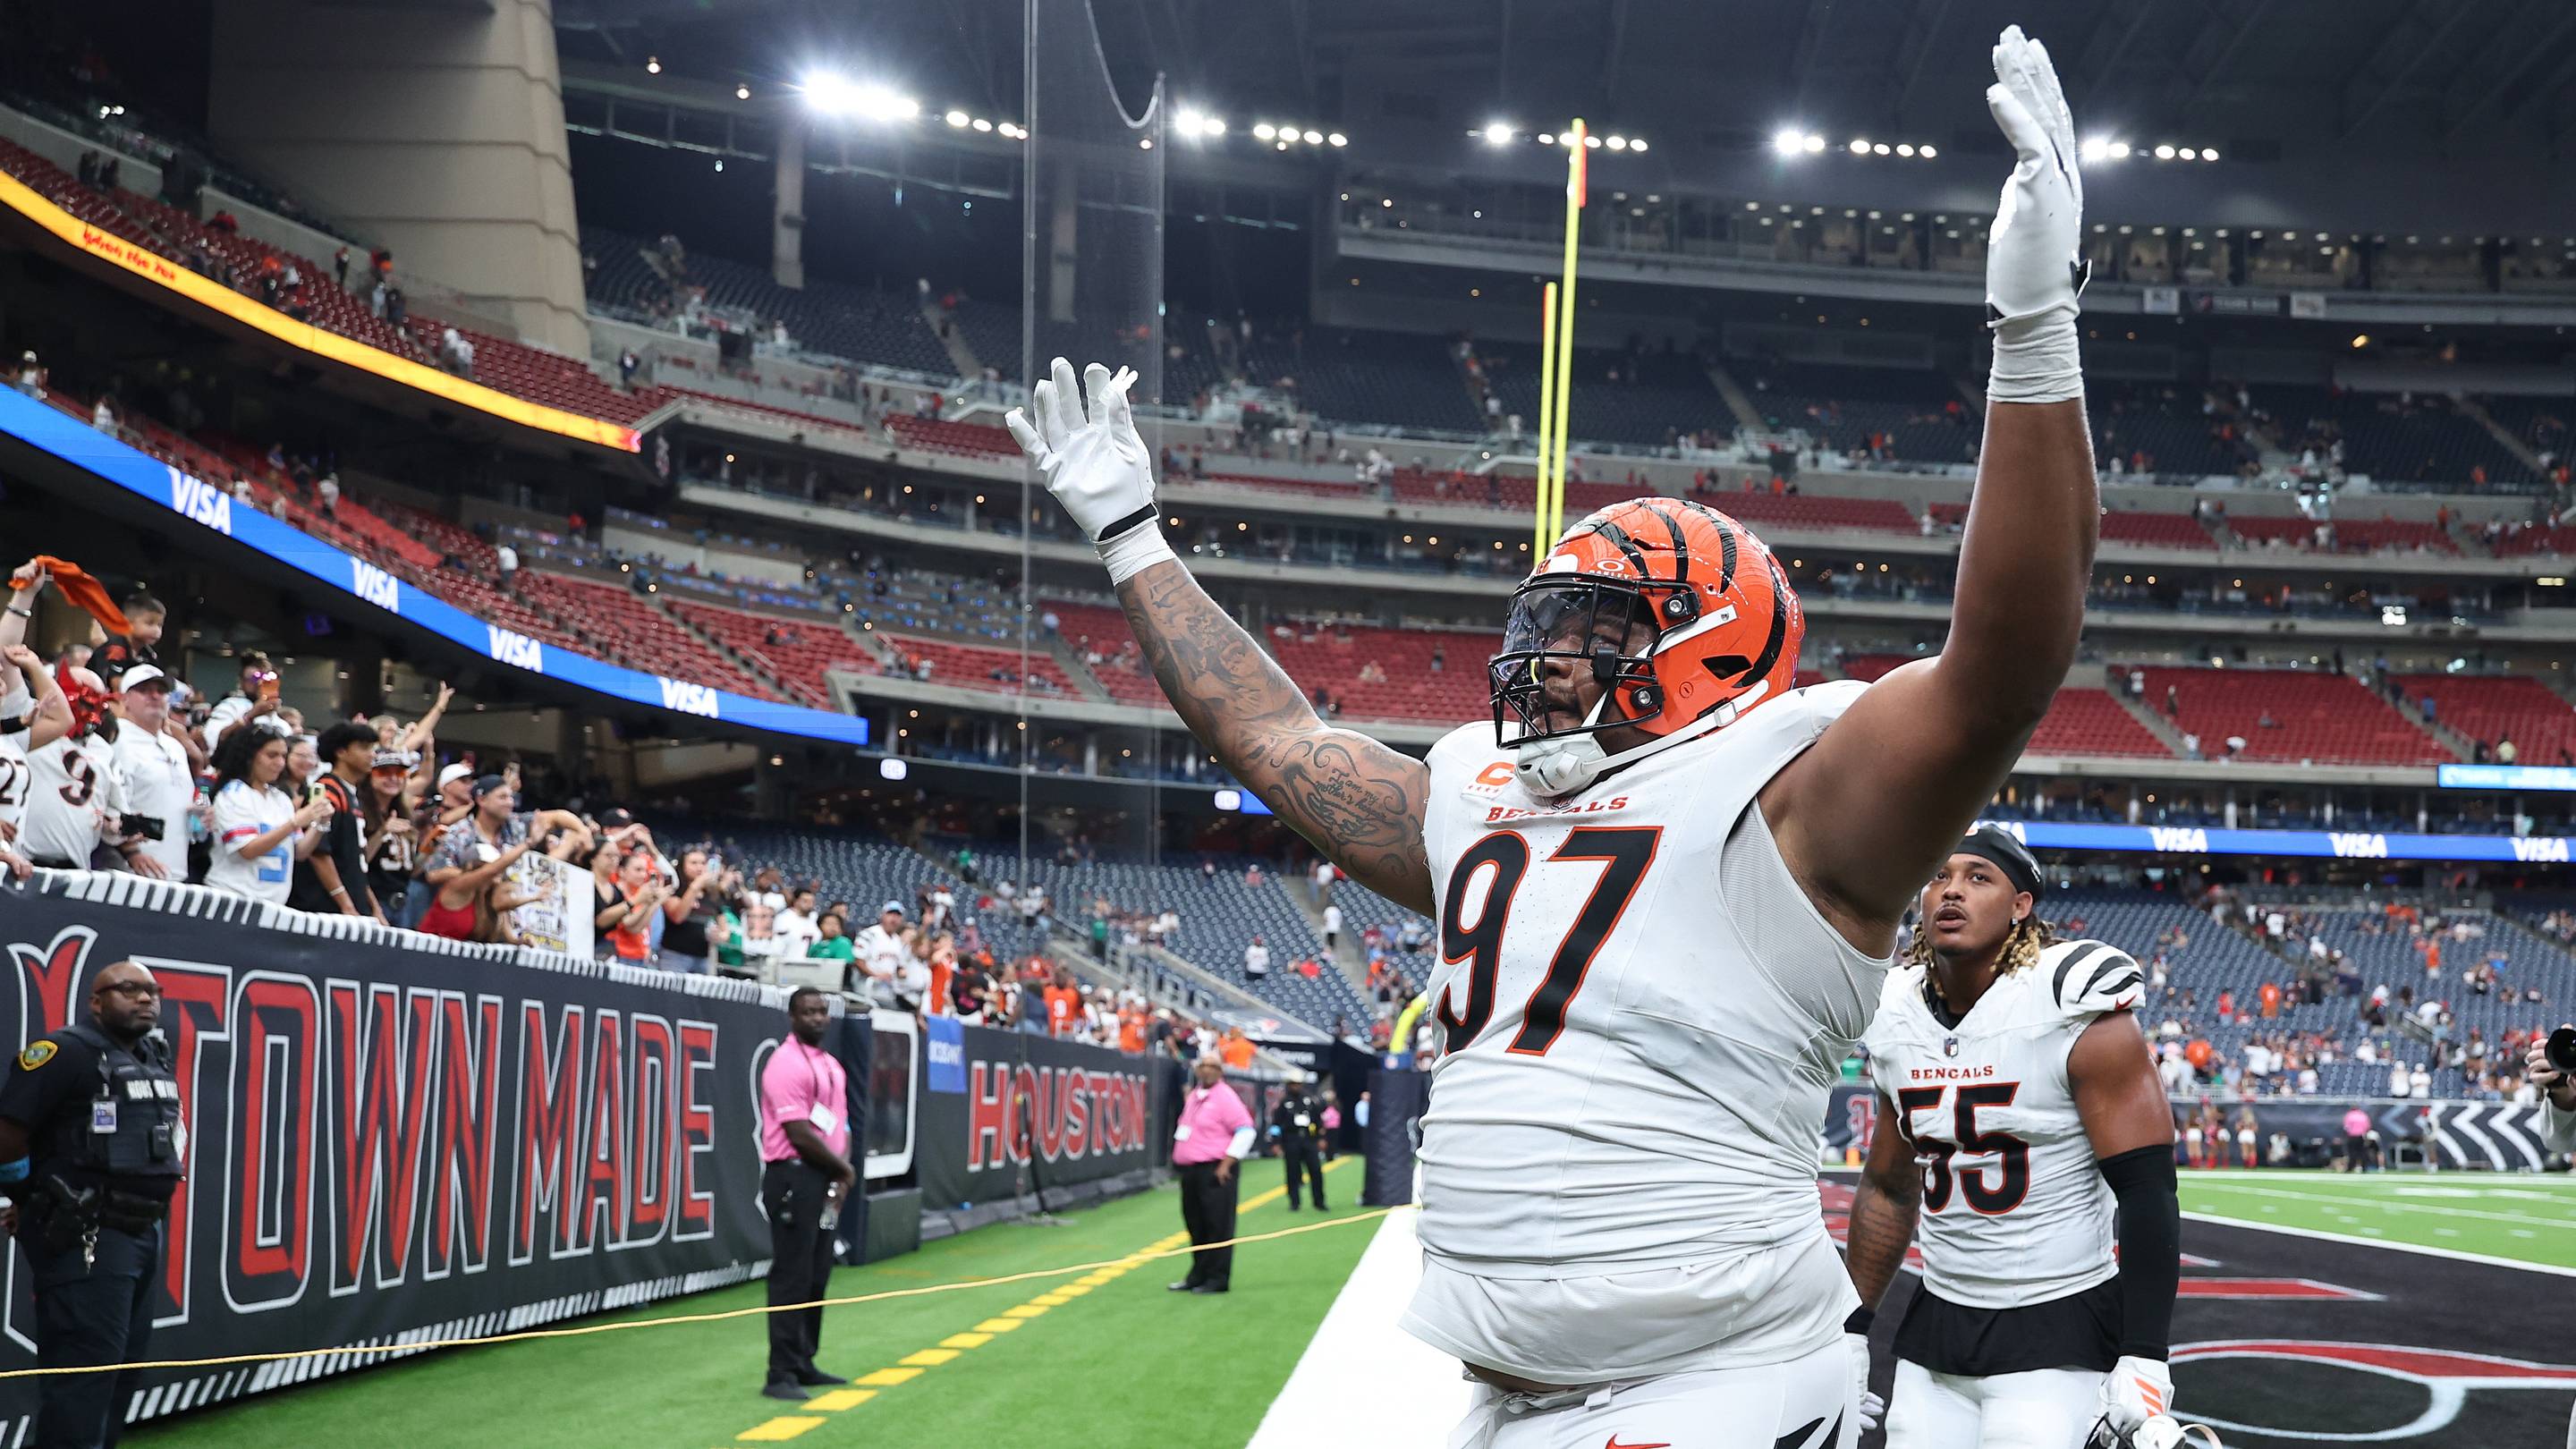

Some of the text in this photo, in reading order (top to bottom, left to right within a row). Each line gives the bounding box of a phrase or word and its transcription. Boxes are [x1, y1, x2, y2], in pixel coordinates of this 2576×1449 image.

[166, 464, 233, 537] VISA
[350, 555, 399, 614] VISA
[487, 624, 543, 674] VISA
[657, 676, 719, 719] VISA
[59, 750, 96, 808] 9
[2149, 826, 2208, 852] VISA
[2327, 832, 2389, 859] VISA
[2509, 837, 2570, 862] VISA
[1437, 826, 1664, 1056] 97
[1911, 1065, 1994, 1080] BENGALS
[507, 999, 718, 1267] MADE
[967, 1060, 1147, 1173] HOUSTON
[1897, 1081, 2029, 1216] 55
